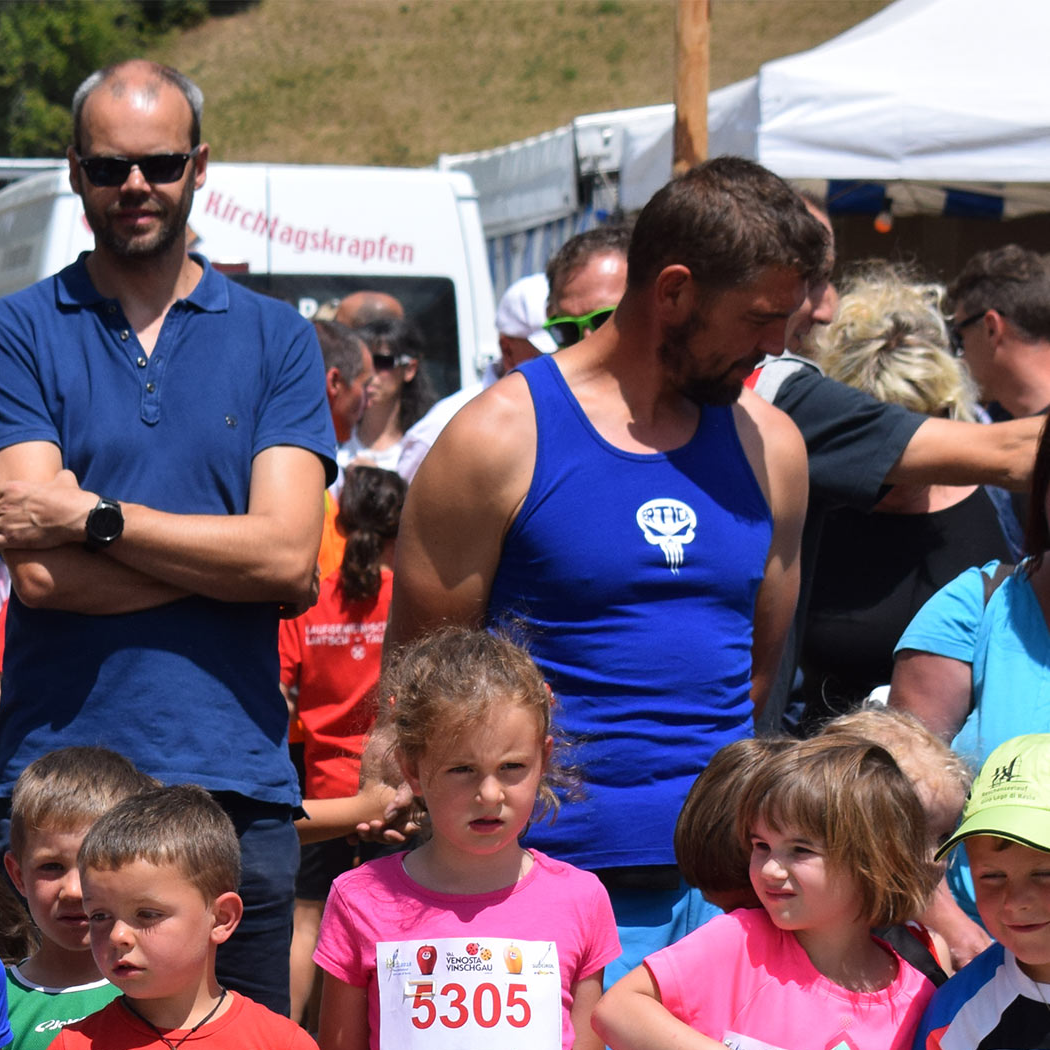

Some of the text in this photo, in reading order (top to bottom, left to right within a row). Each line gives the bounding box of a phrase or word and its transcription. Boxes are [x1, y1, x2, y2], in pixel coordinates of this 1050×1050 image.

[204, 189, 415, 265] Kirchtagskrapfen
[446, 957, 482, 965] VENOSTA
[446, 964, 493, 972] VINSCHGAU
[411, 982, 532, 1029] 5305
